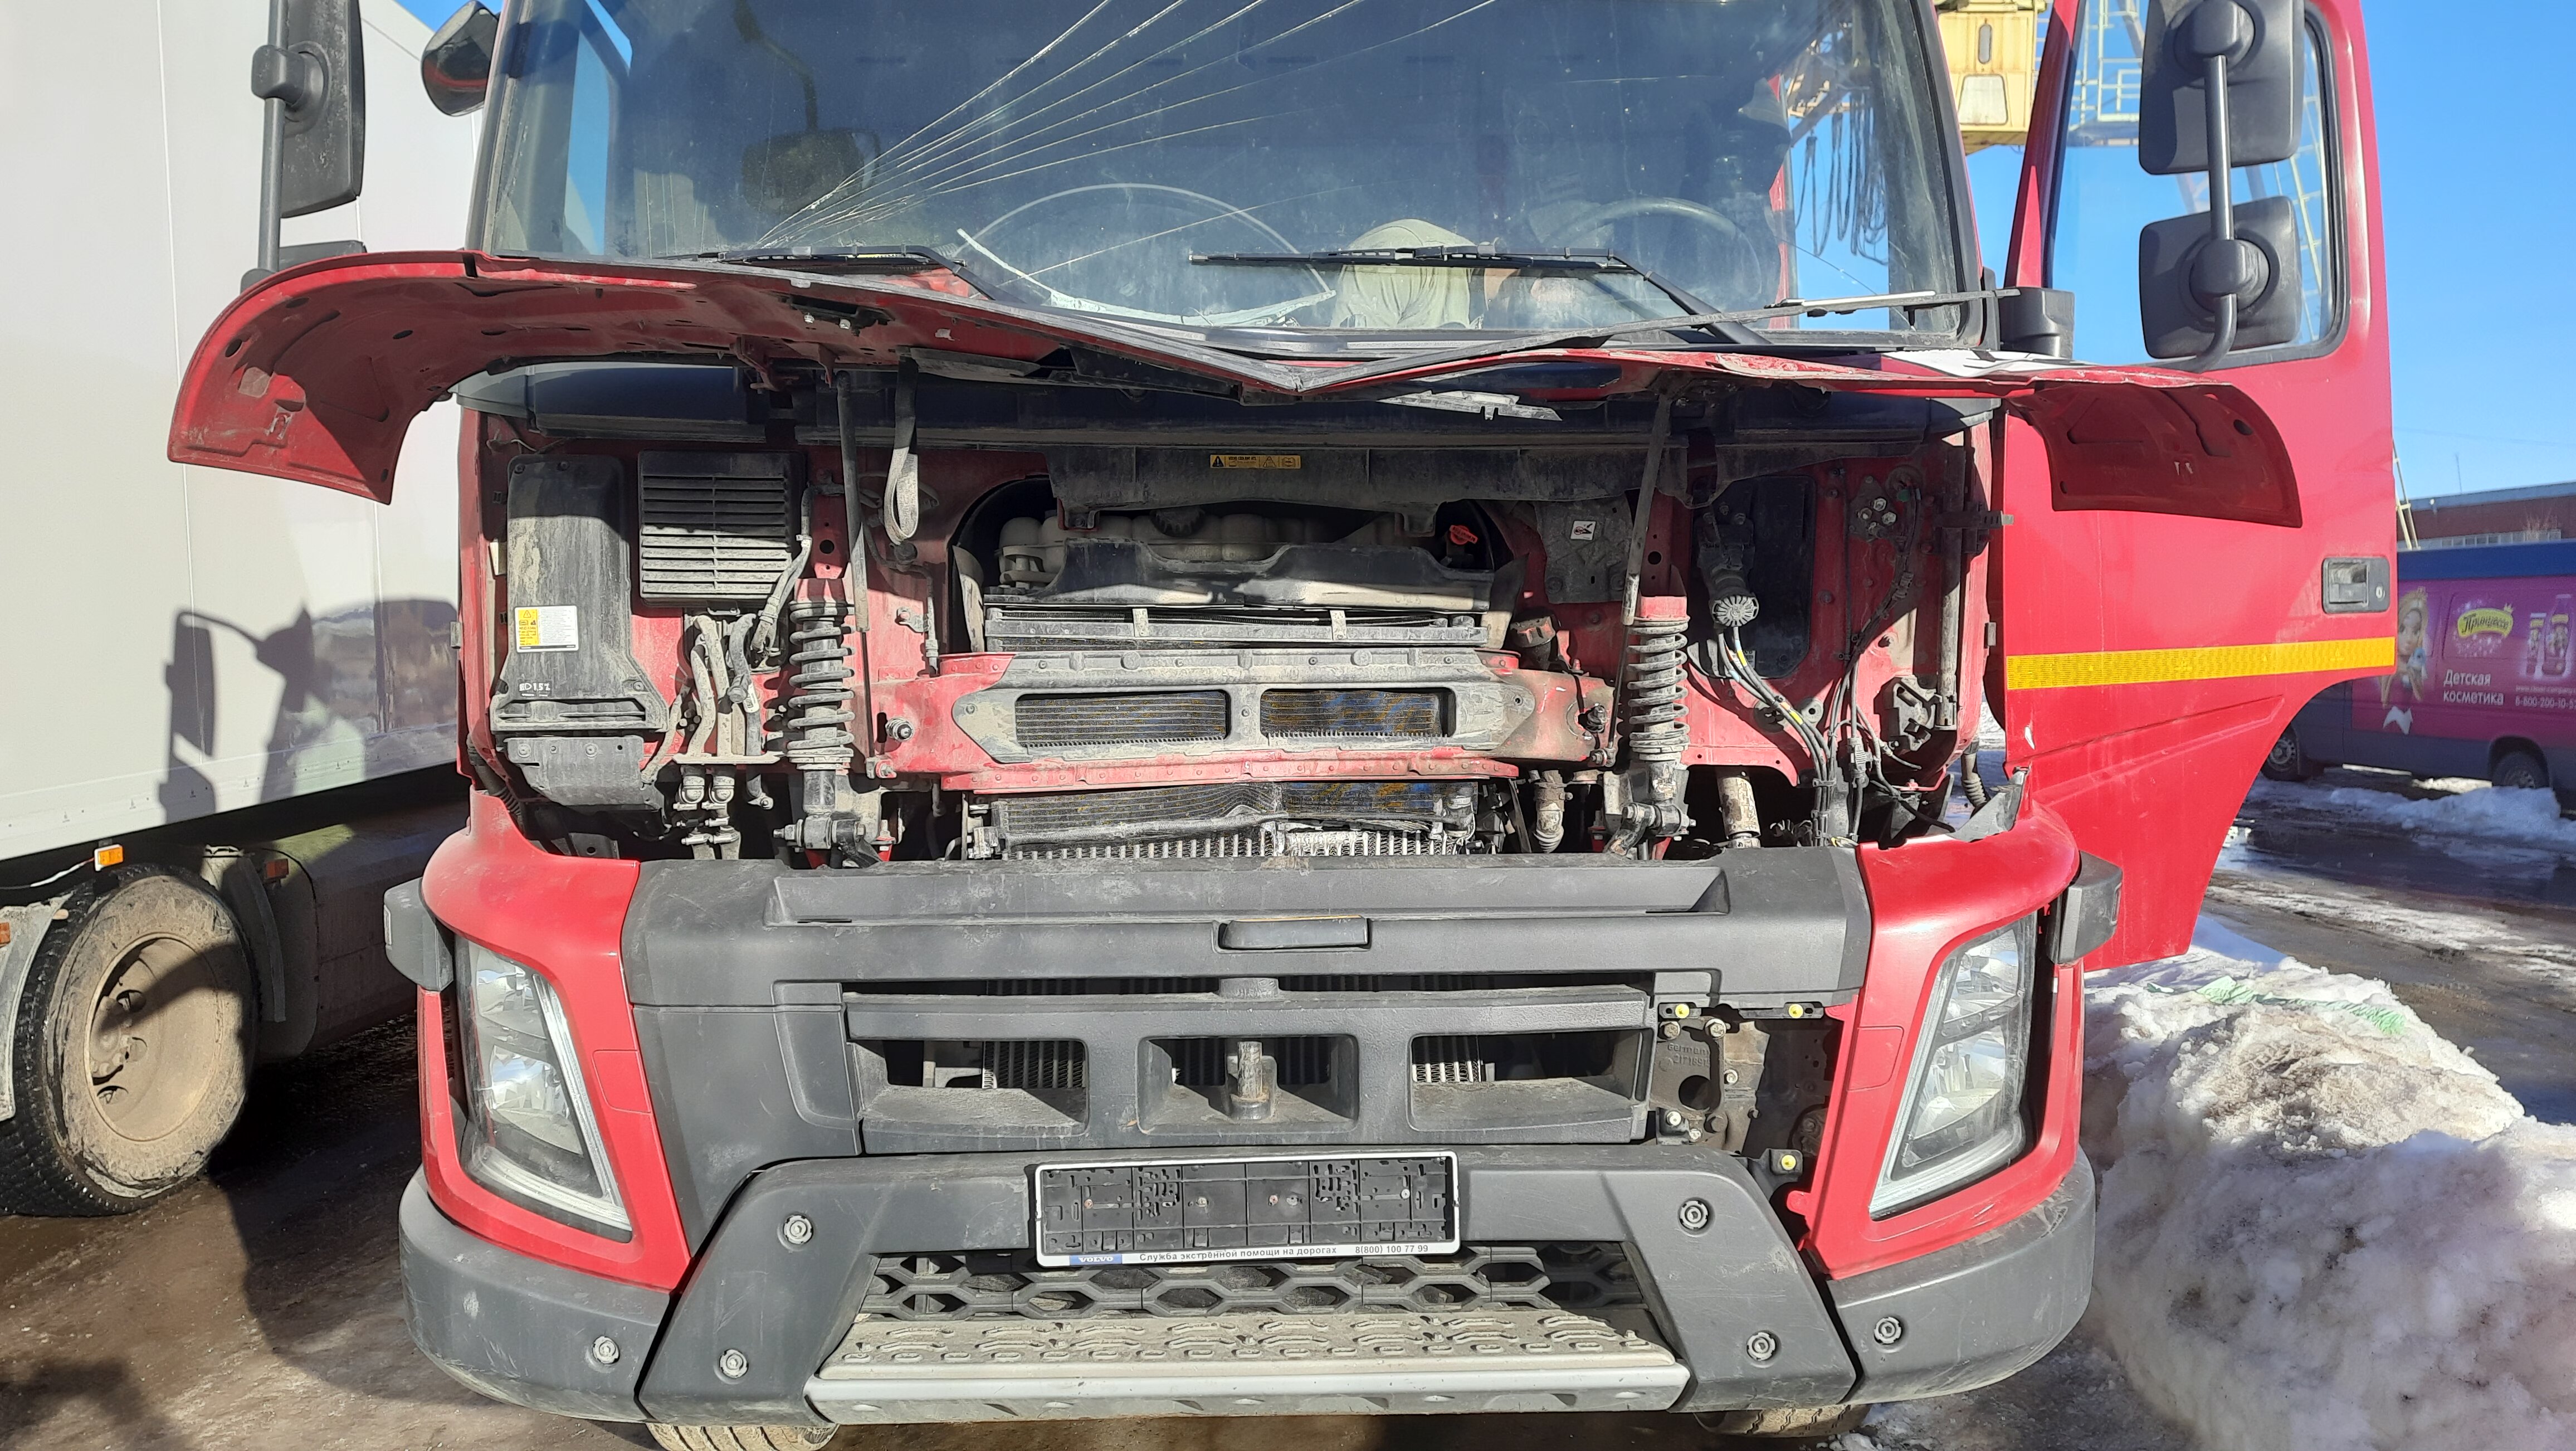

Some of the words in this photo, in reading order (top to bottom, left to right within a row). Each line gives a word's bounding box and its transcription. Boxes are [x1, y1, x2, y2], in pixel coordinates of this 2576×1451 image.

[2443, 669, 2491, 687] Детская
[2443, 690, 2504, 705] косметика
[1139, 1253, 1177, 1262] Служба
[1181, 1250, 1237, 1260] экстренной
[1296, 1247, 1336, 1256] дорогах
[1355, 1245, 1383, 1254] 8(800)
